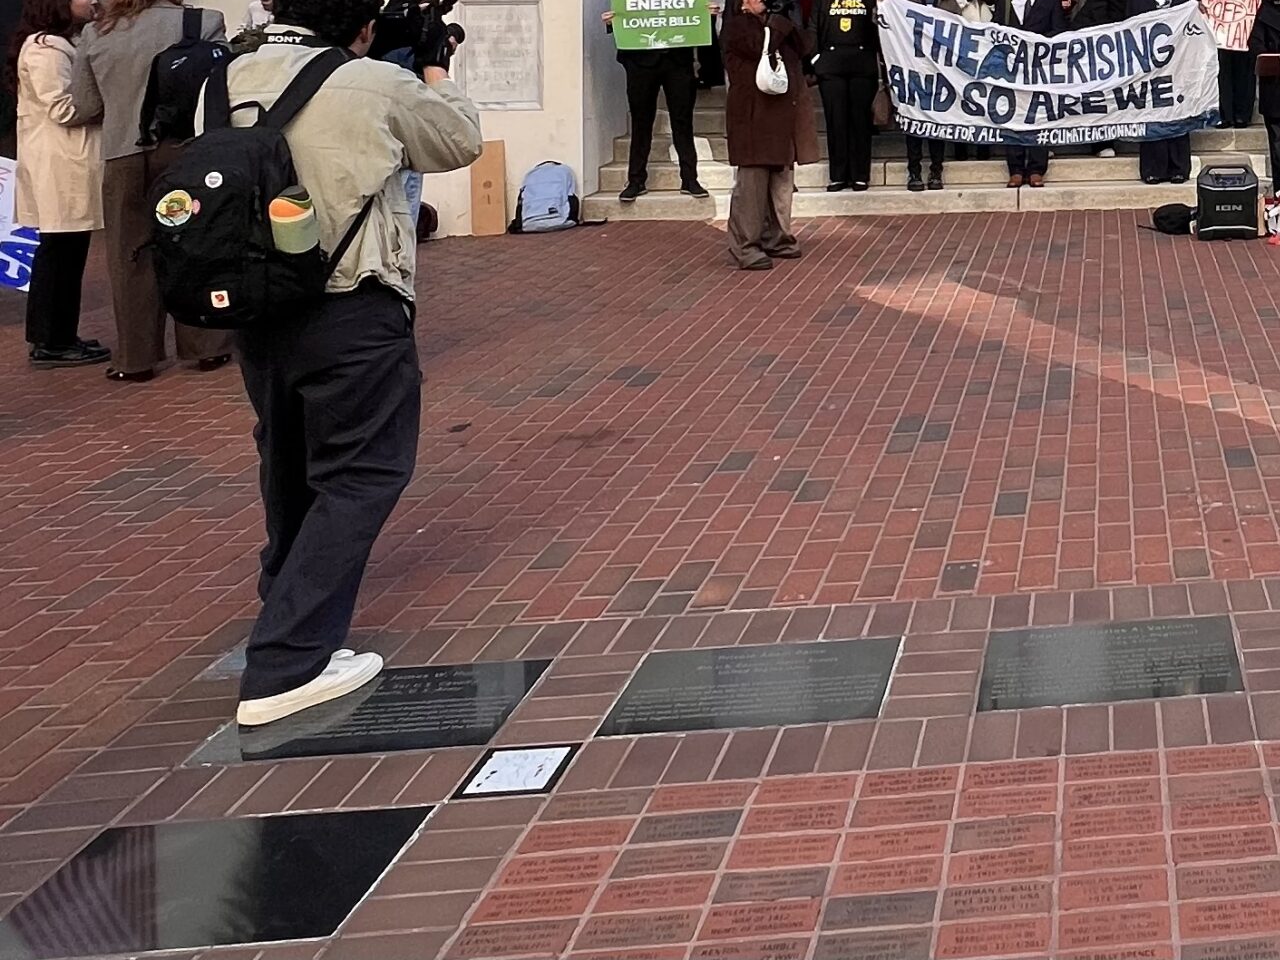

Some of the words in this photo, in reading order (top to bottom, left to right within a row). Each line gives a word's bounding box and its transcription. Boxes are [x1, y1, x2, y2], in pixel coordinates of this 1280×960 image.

[623, 16, 666, 29] LOWER
[668, 15, 701, 28] BILLS
[1213, 2, 1243, 22] OFF
[267, 35, 303, 43] SONY
[906, 8, 988, 80] THE
[990, 29, 1021, 47] SEAS
[1014, 39, 1068, 86] ARE
[1068, 21, 1176, 84] RISING
[888, 64, 957, 113] AND
[960, 81, 1017, 125] SO
[1026, 88, 1109, 125] ARE
[1108, 75, 1185, 111] WE.
[909, 118, 954, 141] FUTURE
[954, 124, 977, 142] FOR
[977, 127, 1004, 143] ALL
[1215, 204, 1243, 212] ION
